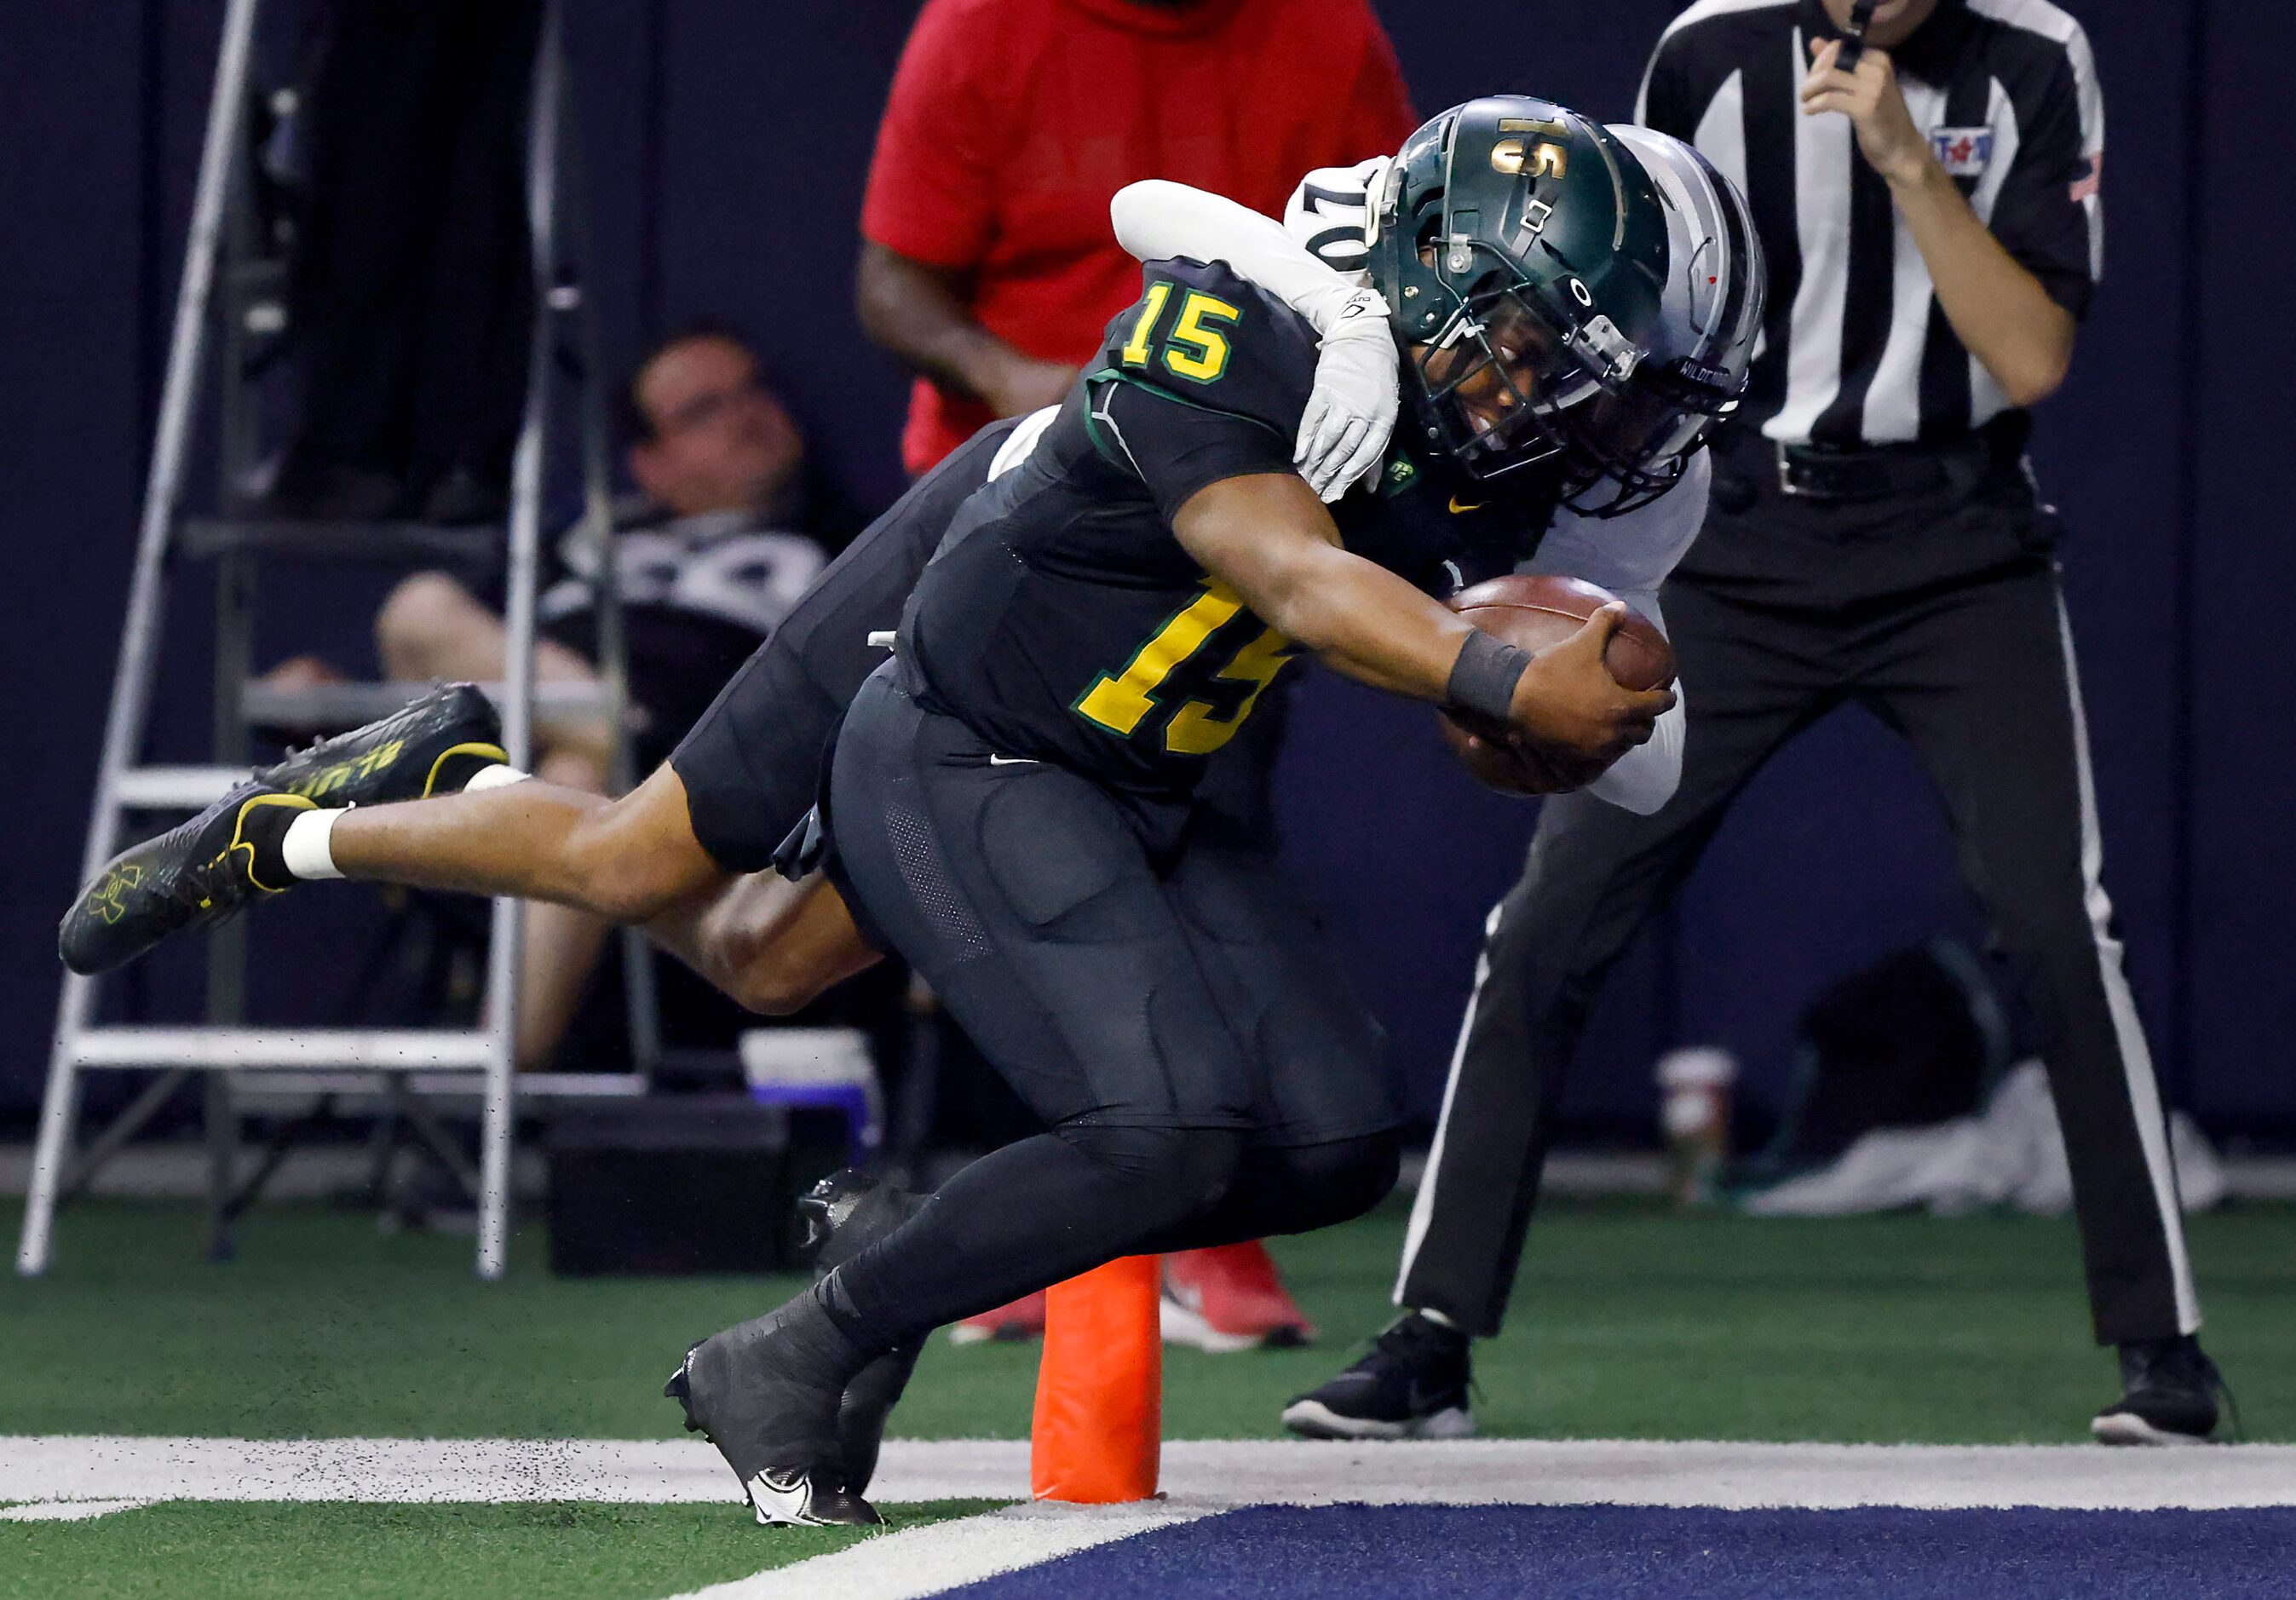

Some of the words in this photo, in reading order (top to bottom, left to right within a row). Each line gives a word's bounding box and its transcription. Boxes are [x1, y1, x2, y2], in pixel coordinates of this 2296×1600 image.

[1490, 117, 1573, 180] 15
[1122, 280, 1245, 385] 15
[1070, 574, 1298, 755] 15
